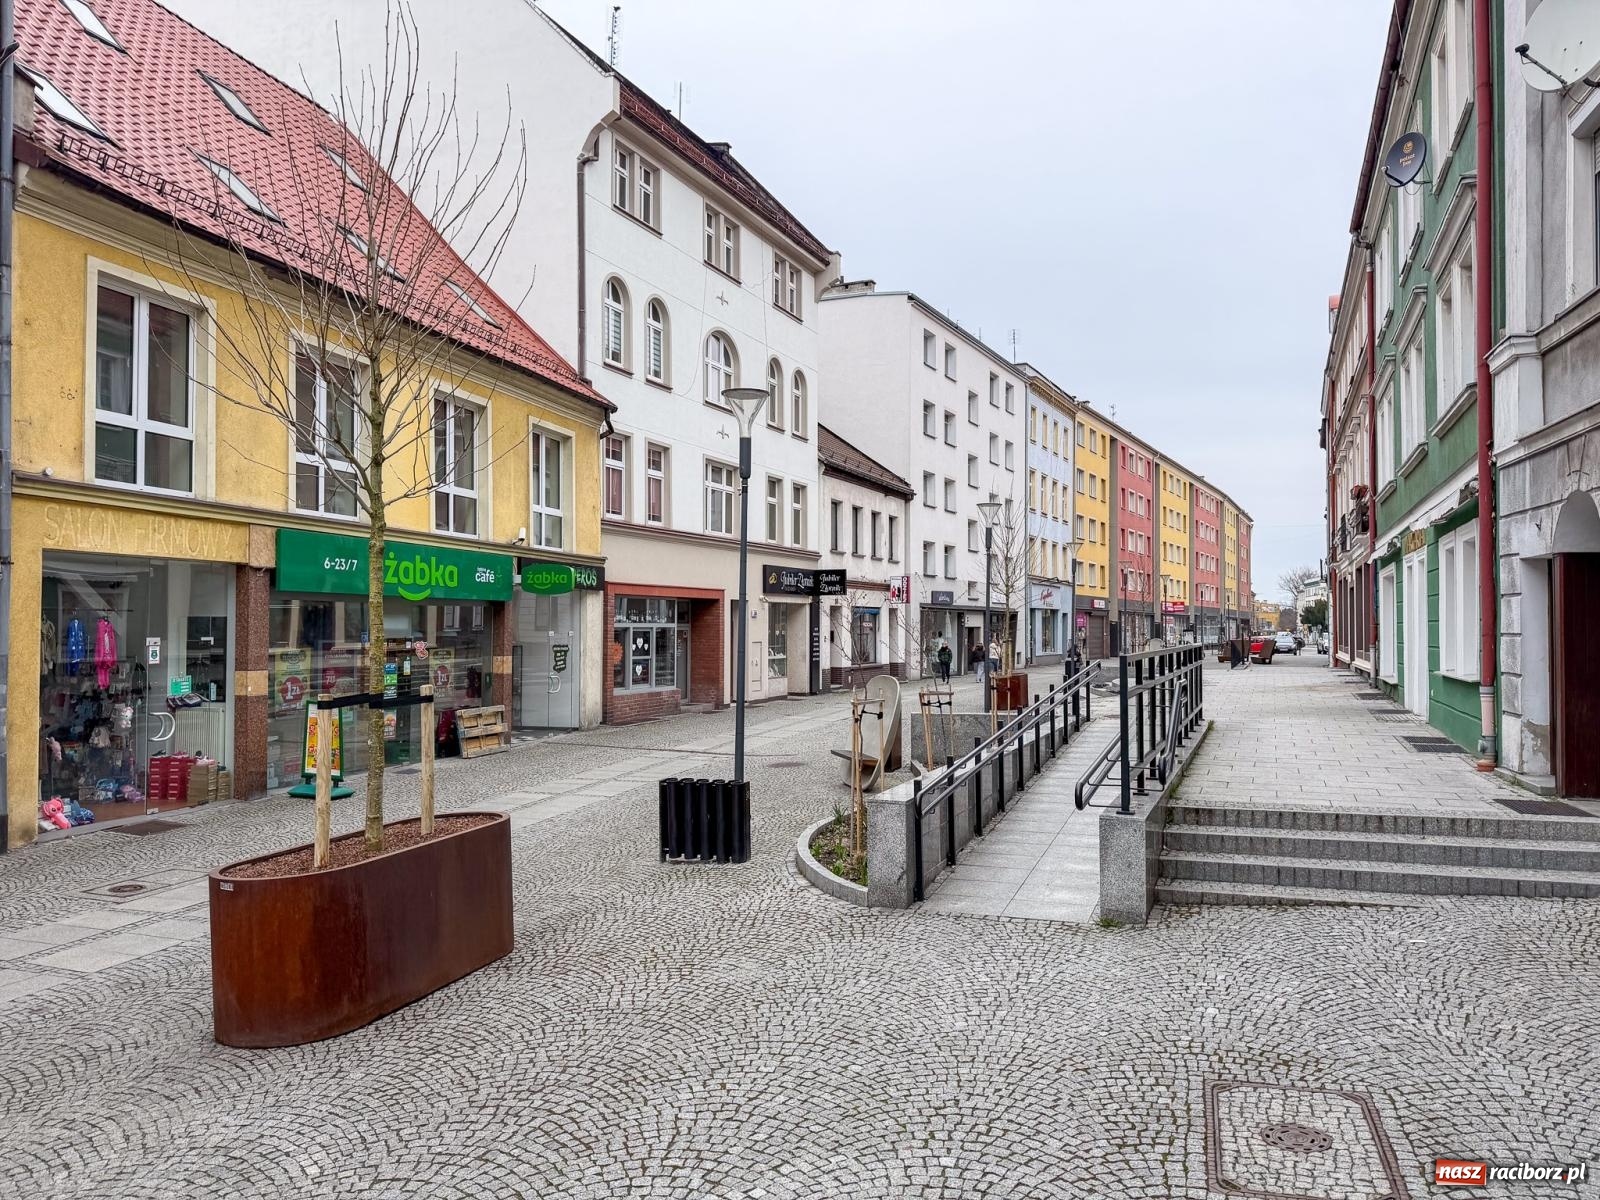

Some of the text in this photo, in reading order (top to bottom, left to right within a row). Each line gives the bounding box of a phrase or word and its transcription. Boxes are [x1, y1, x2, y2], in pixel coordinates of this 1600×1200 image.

[44, 504, 233, 559] SALON FIRMOWY
[323, 556, 358, 572] 6-23/7
[384, 551, 458, 588] żabka
[527, 571, 567, 584] żabka
